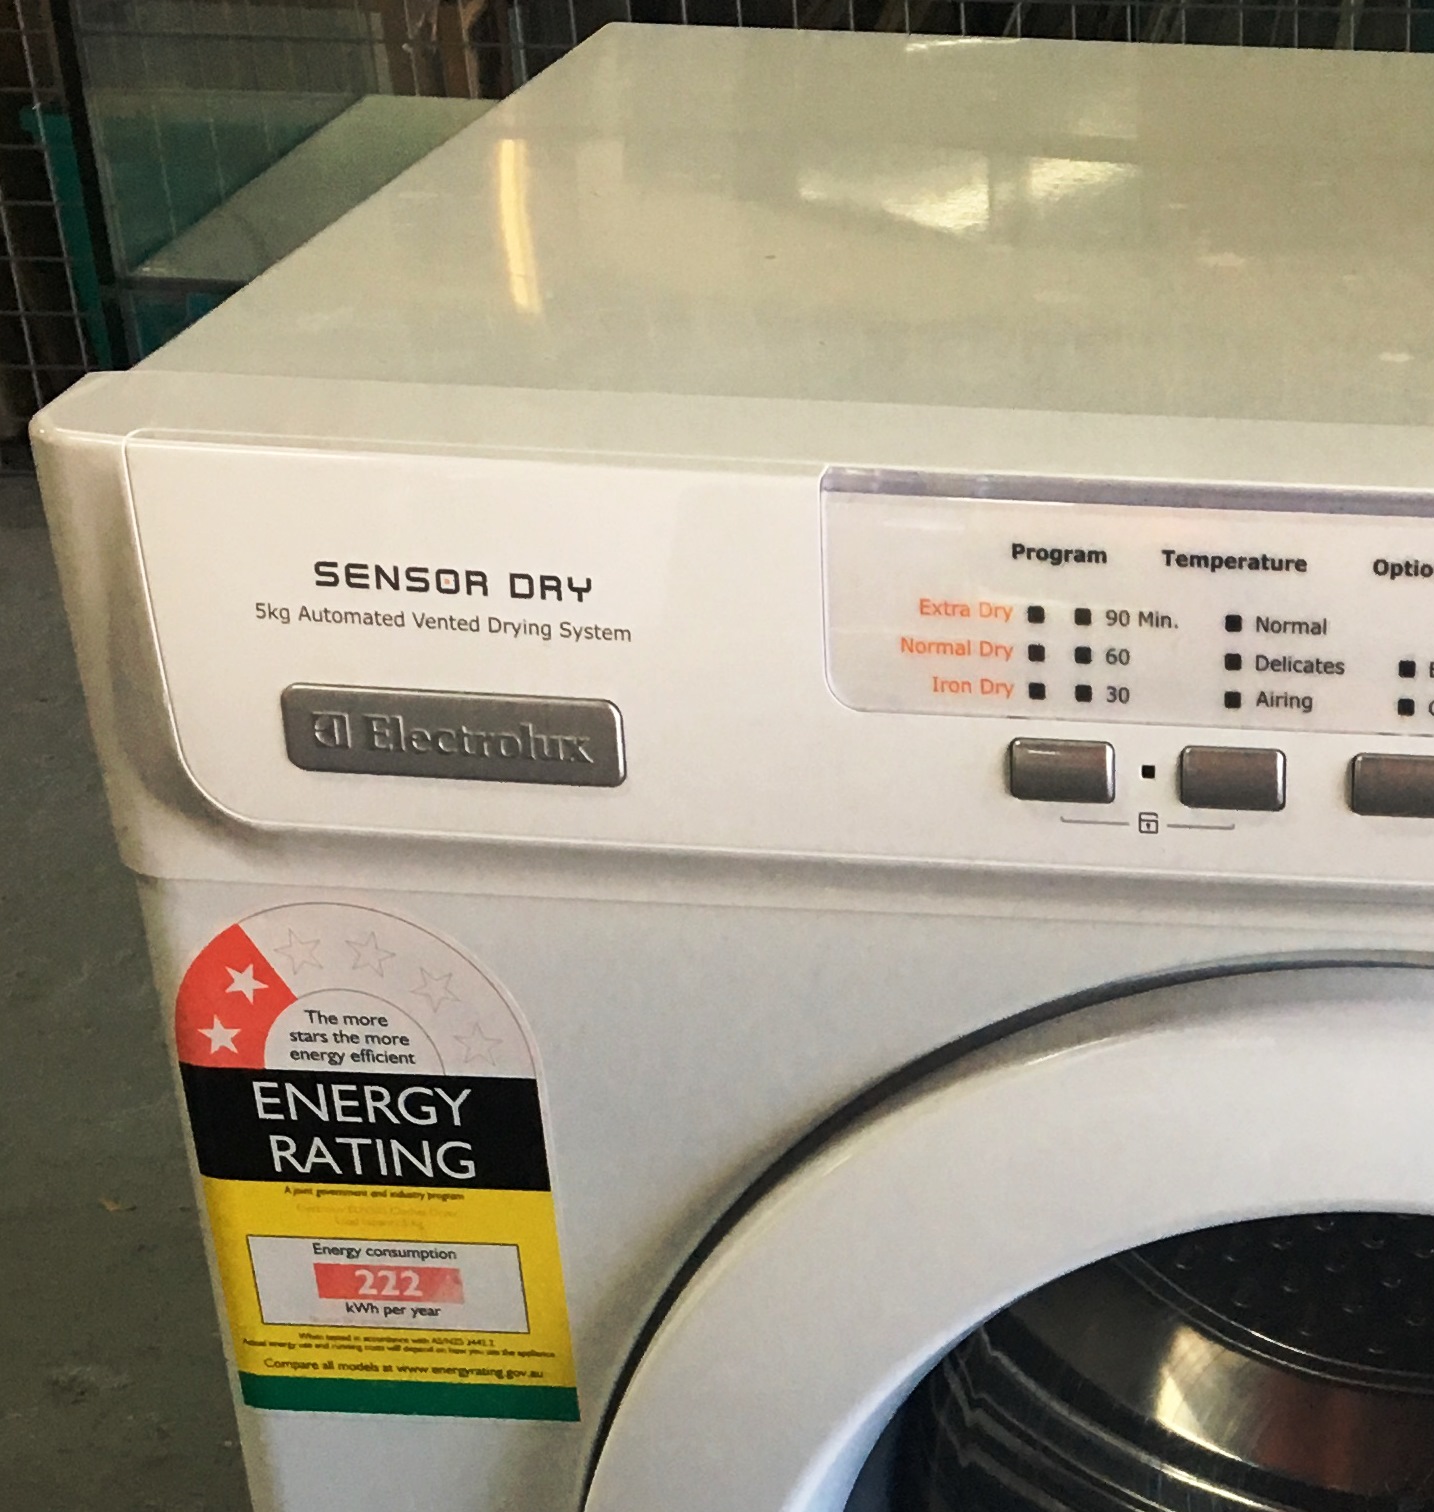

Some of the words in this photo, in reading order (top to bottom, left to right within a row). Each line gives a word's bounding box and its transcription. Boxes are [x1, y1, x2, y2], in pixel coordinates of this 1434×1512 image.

[1011, 543, 1107, 567] Program
[1162, 549, 1308, 573] Temperature
[314, 561, 489, 596] SENSOR
[509, 572, 592, 602] DRY
[919, 598, 970, 619] Extra
[979, 602, 1014, 622] Dry
[1106, 609, 1130, 628] 90
[1138, 611, 1179, 630] Min.
[255, 602, 291, 624] 5kg
[298, 605, 405, 628] Automated
[412, 611, 480, 633] Vented
[488, 616, 552, 641] Drying
[559, 621, 632, 643] System
[1256, 615, 1327, 636] Normal
[900, 637, 971, 657] Normal
[980, 641, 1014, 661] Dry
[1106, 648, 1130, 666] 60
[1256, 655, 1345, 676] Delicates
[933, 676, 971, 695] Iron
[981, 679, 1014, 698] Dry
[1106, 686, 1130, 704] 30
[1256, 691, 1313, 713] Airing
[361, 714, 595, 764] Electrolux
[304, 1009, 338, 1026] The
[343, 1013, 388, 1027] more
[289, 1029, 329, 1044] stars
[333, 1031, 360, 1044] the
[365, 1033, 410, 1047] more
[290, 1049, 345, 1066] energy
[350, 1049, 416, 1066] efficient
[252, 1081, 472, 1127] ENERGY
[269, 1135, 475, 1180] RATING
[313, 1243, 361, 1259] Energy
[365, 1245, 458, 1261] consumption
[355, 1269, 423, 1297] 222
[345, 1302, 380, 1315] kWh
[383, 1305, 405, 1317] per
[411, 1306, 441, 1318] year
[263, 1358, 319, 1371] Compare
[322, 1360, 334, 1370] all
[338, 1363, 379, 1372] models
